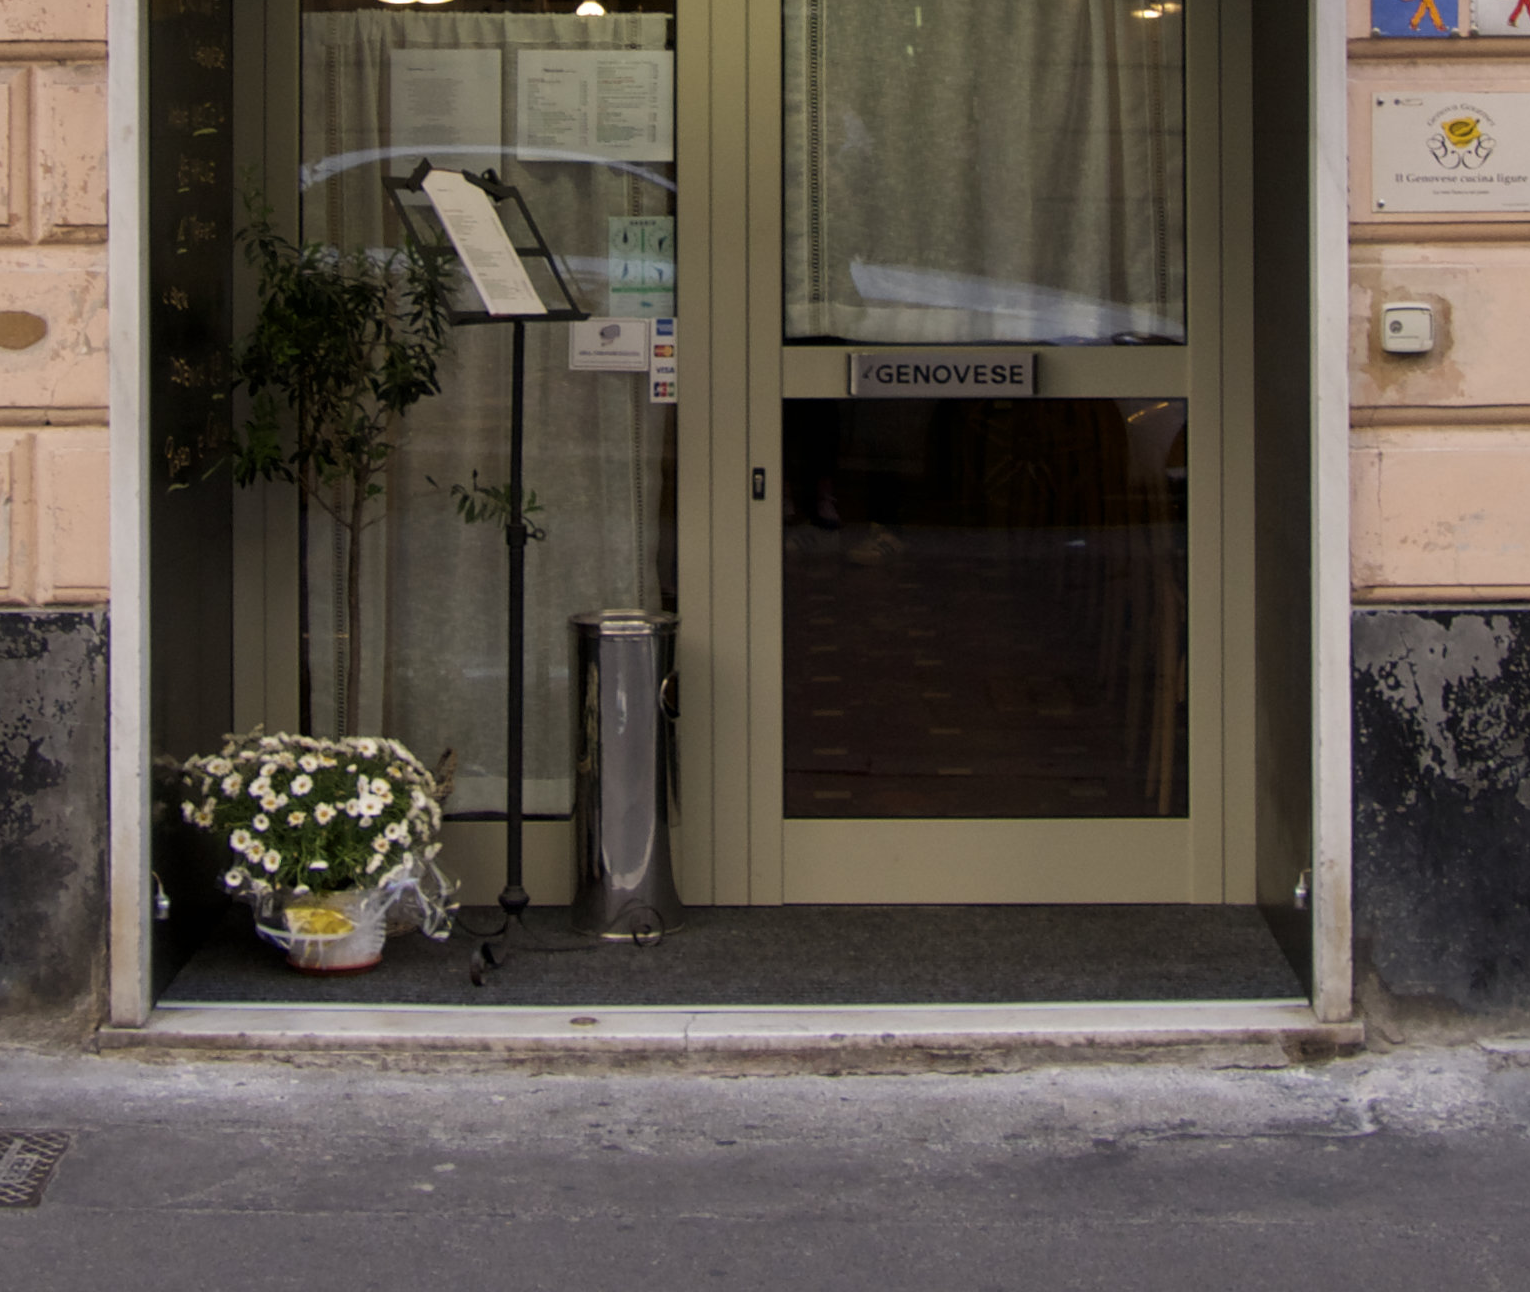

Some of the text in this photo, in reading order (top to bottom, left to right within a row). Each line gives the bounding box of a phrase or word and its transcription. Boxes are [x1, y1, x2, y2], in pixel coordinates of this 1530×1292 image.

[1406, 173, 1458, 183] Genovese
[1460, 172, 1494, 183] cucina
[1496, 172, 1528, 185] ligure
[875, 364, 1025, 385] GENOVESE
